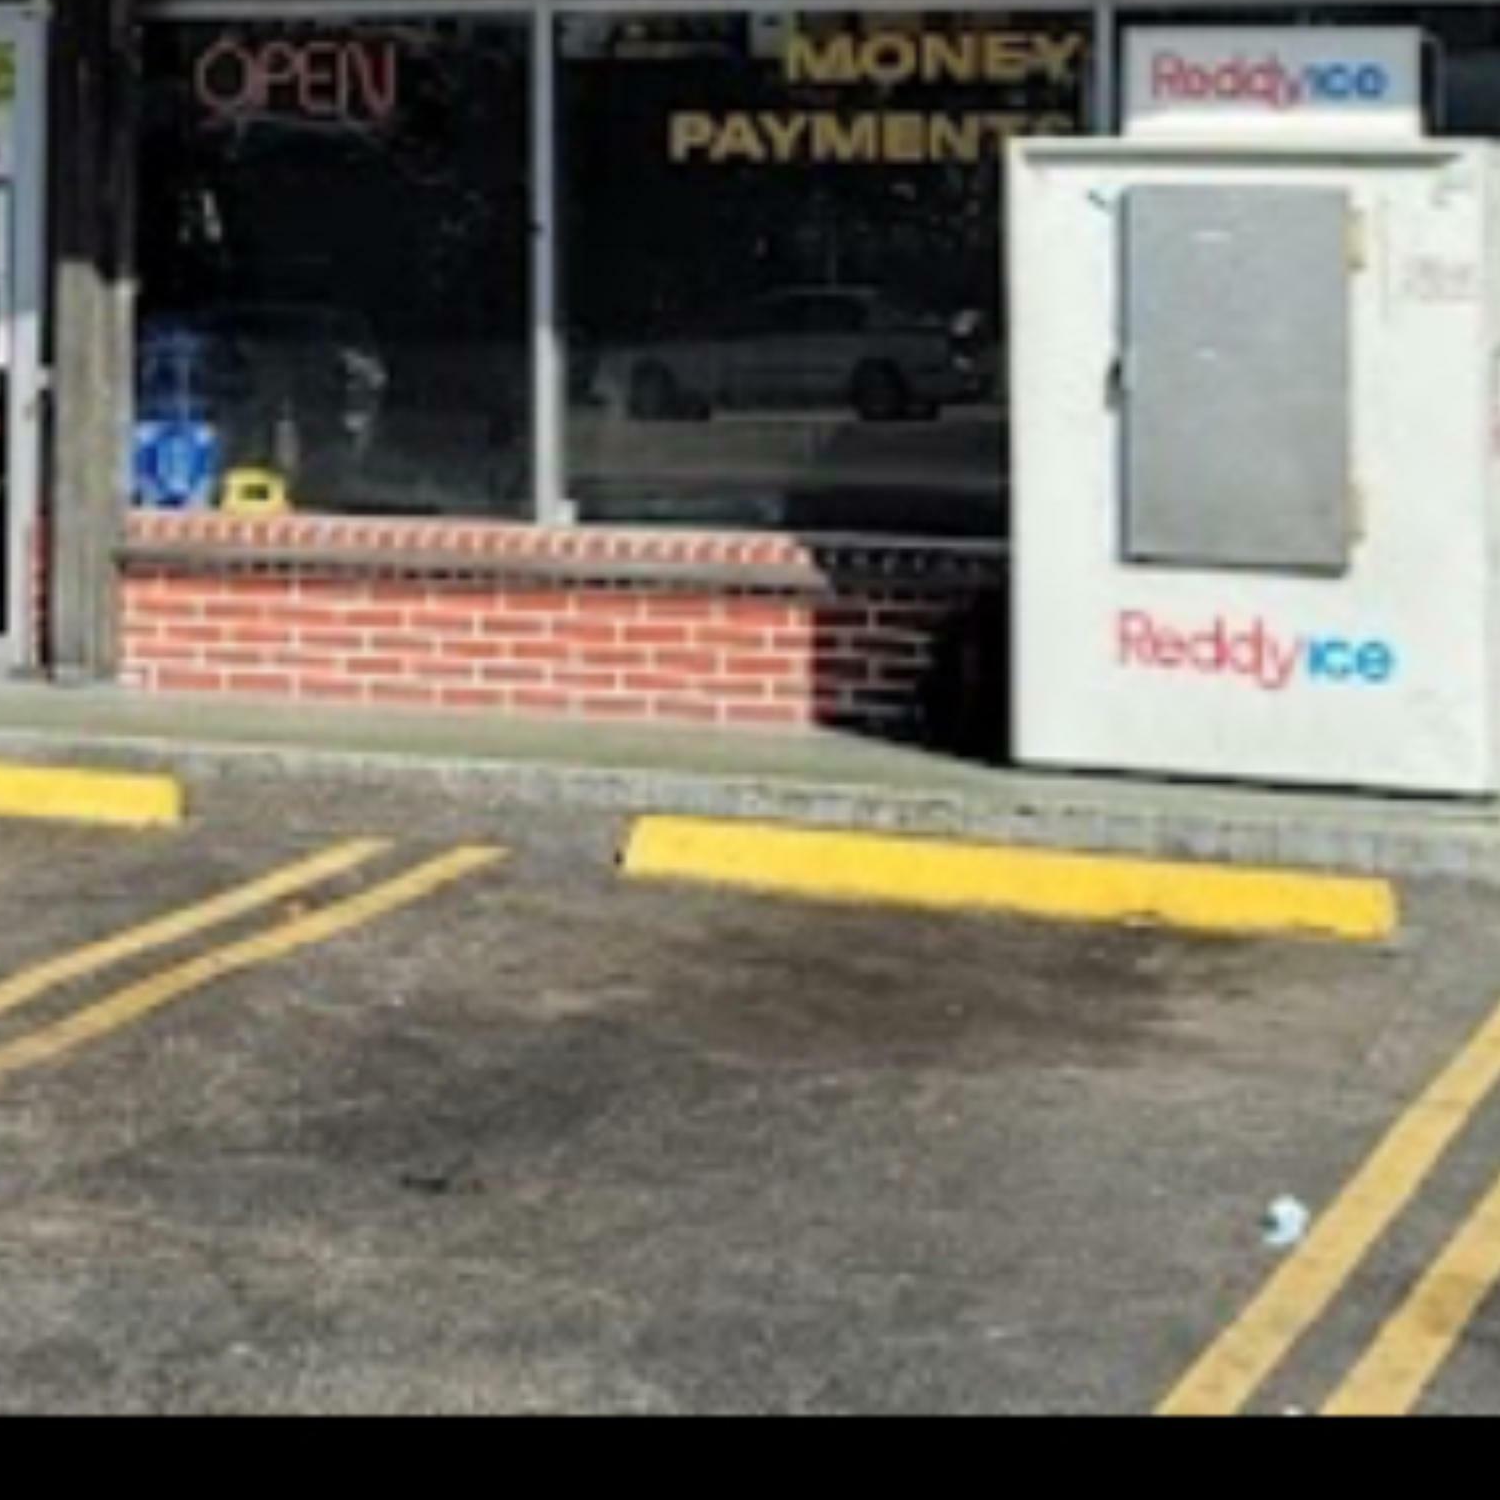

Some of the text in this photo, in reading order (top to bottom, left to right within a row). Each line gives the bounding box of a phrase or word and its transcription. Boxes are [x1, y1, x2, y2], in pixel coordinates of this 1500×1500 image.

[196, 40, 398, 120] OPEN
[784, 32, 1084, 83] MONEY
[1117, 609, 1295, 690] Reddy
